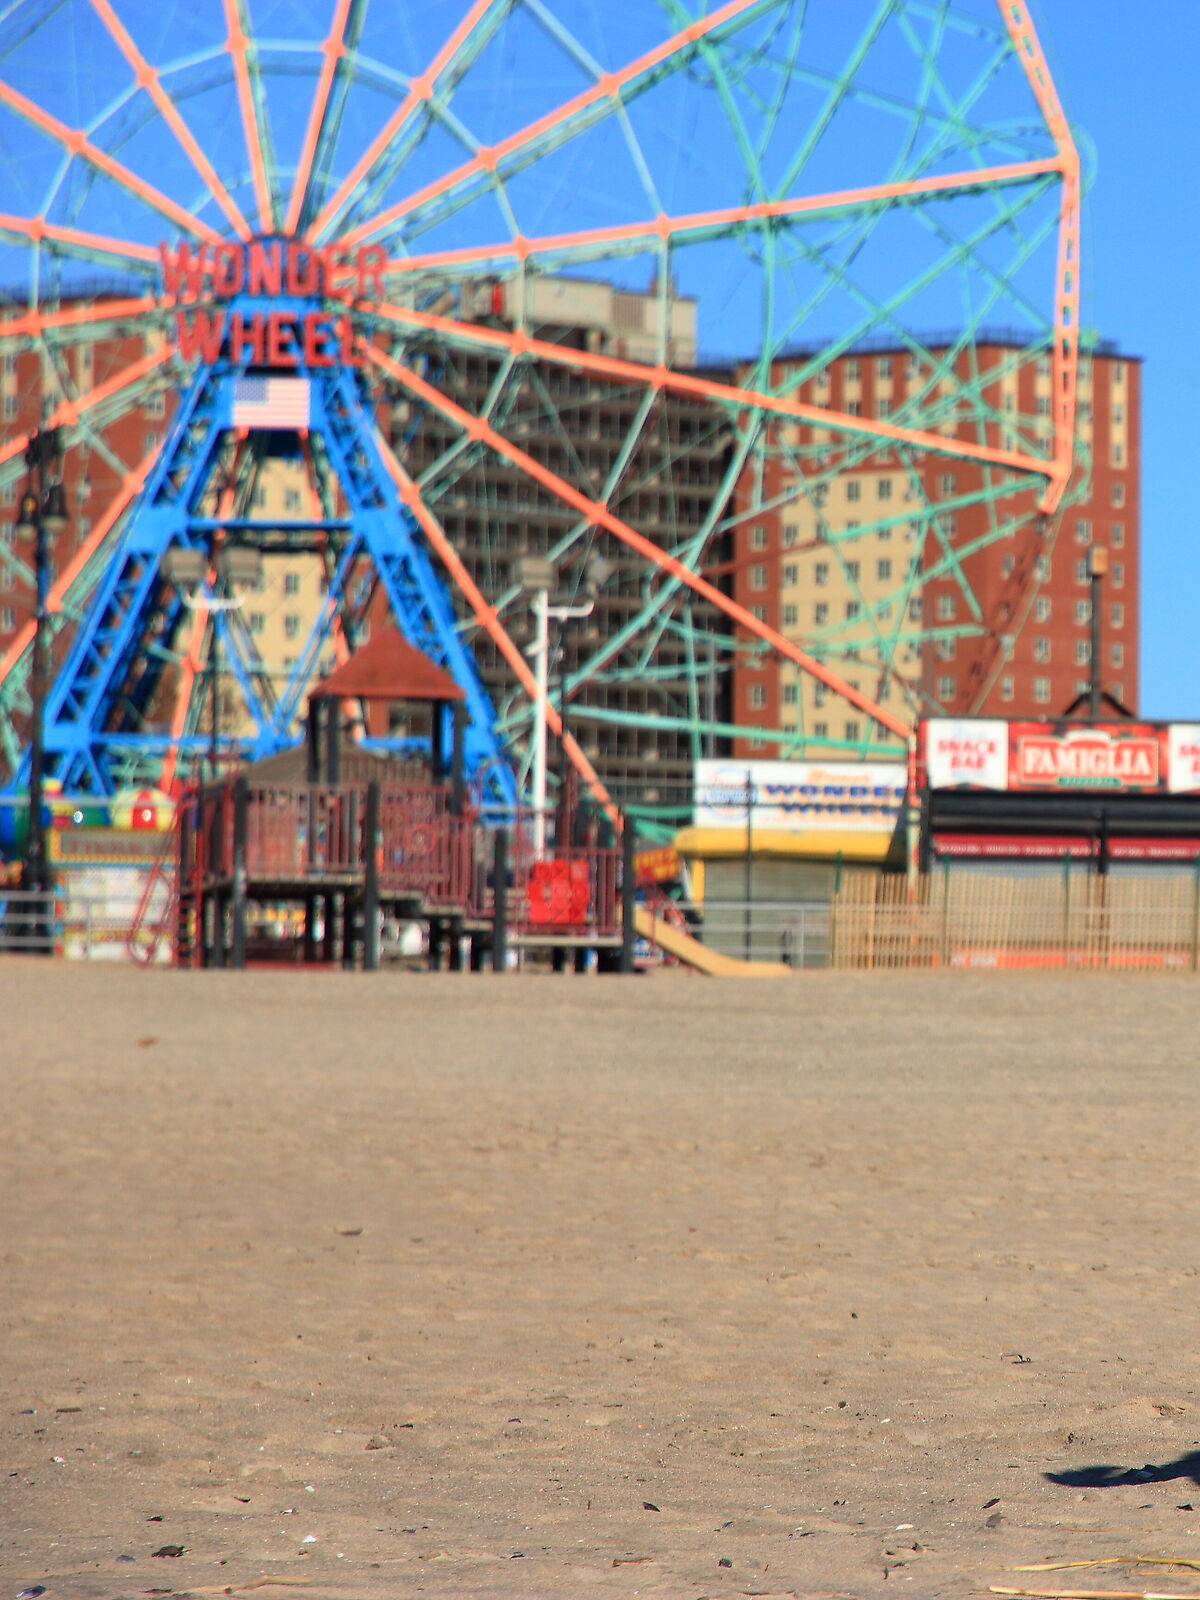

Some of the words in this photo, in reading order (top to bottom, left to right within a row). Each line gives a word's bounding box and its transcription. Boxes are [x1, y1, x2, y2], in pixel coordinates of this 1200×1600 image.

[159, 241, 388, 298] WONDER
[176, 310, 368, 367] WHEEL
[937, 738, 997, 754] SNACK
[1024, 745, 1151, 776] FAMIGLIA
[949, 755, 986, 769] BAR
